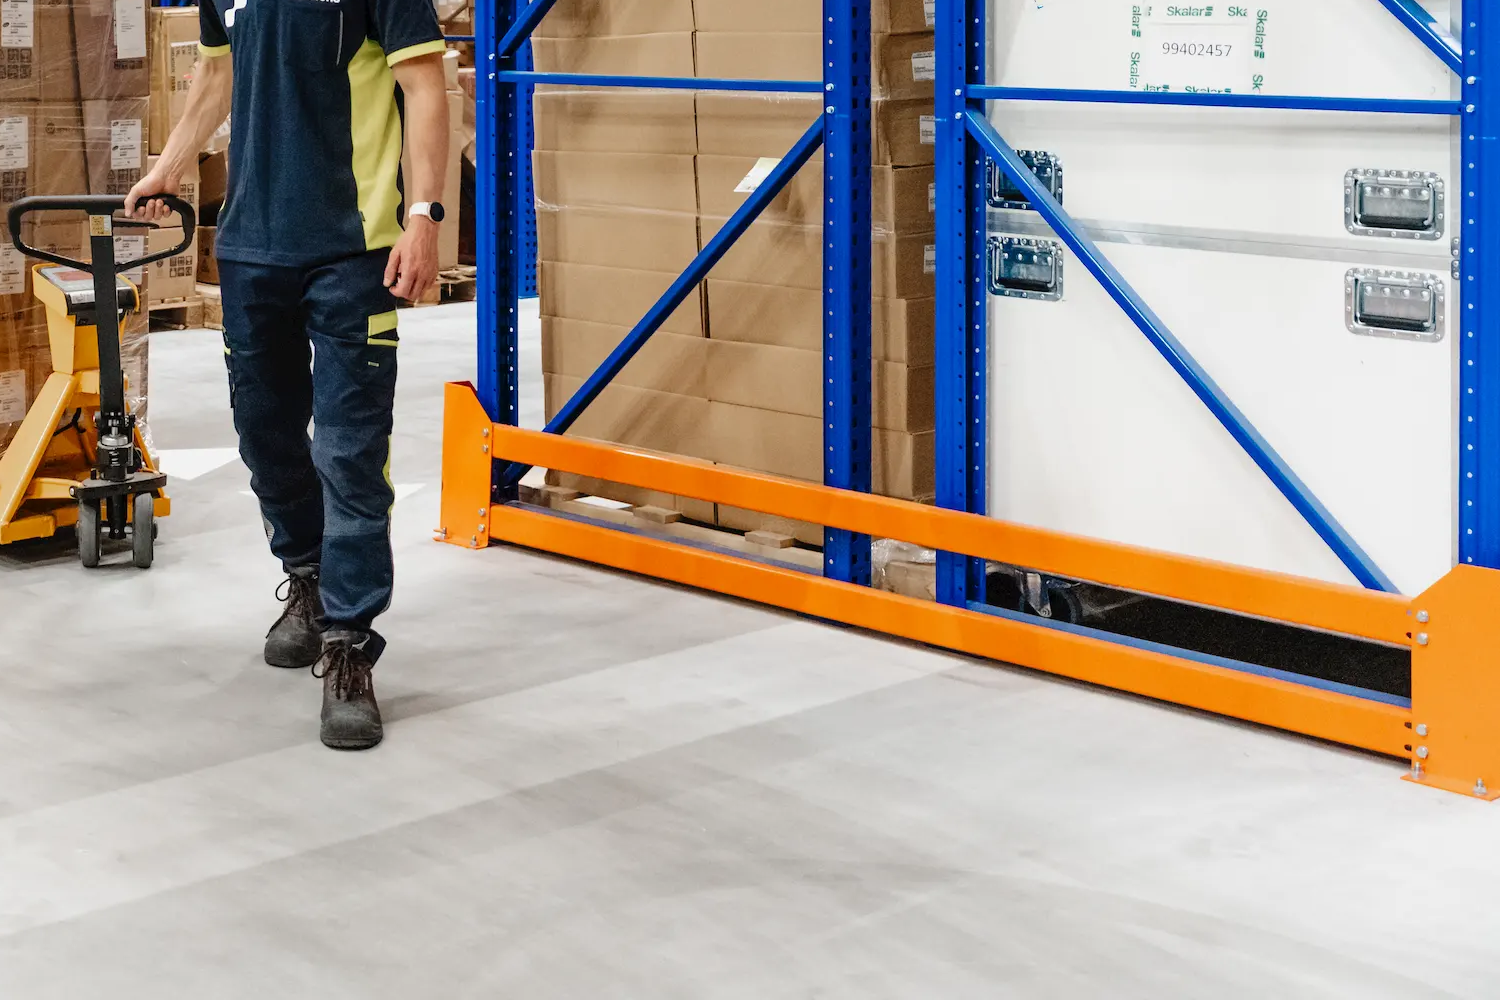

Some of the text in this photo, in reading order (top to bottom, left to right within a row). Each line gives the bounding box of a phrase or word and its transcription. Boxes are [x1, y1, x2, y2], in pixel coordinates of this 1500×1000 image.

[1167, 6, 1204, 17] Skalar
[1254, 9, 1267, 50] Skalar
[1162, 42, 1232, 56] 99402457
